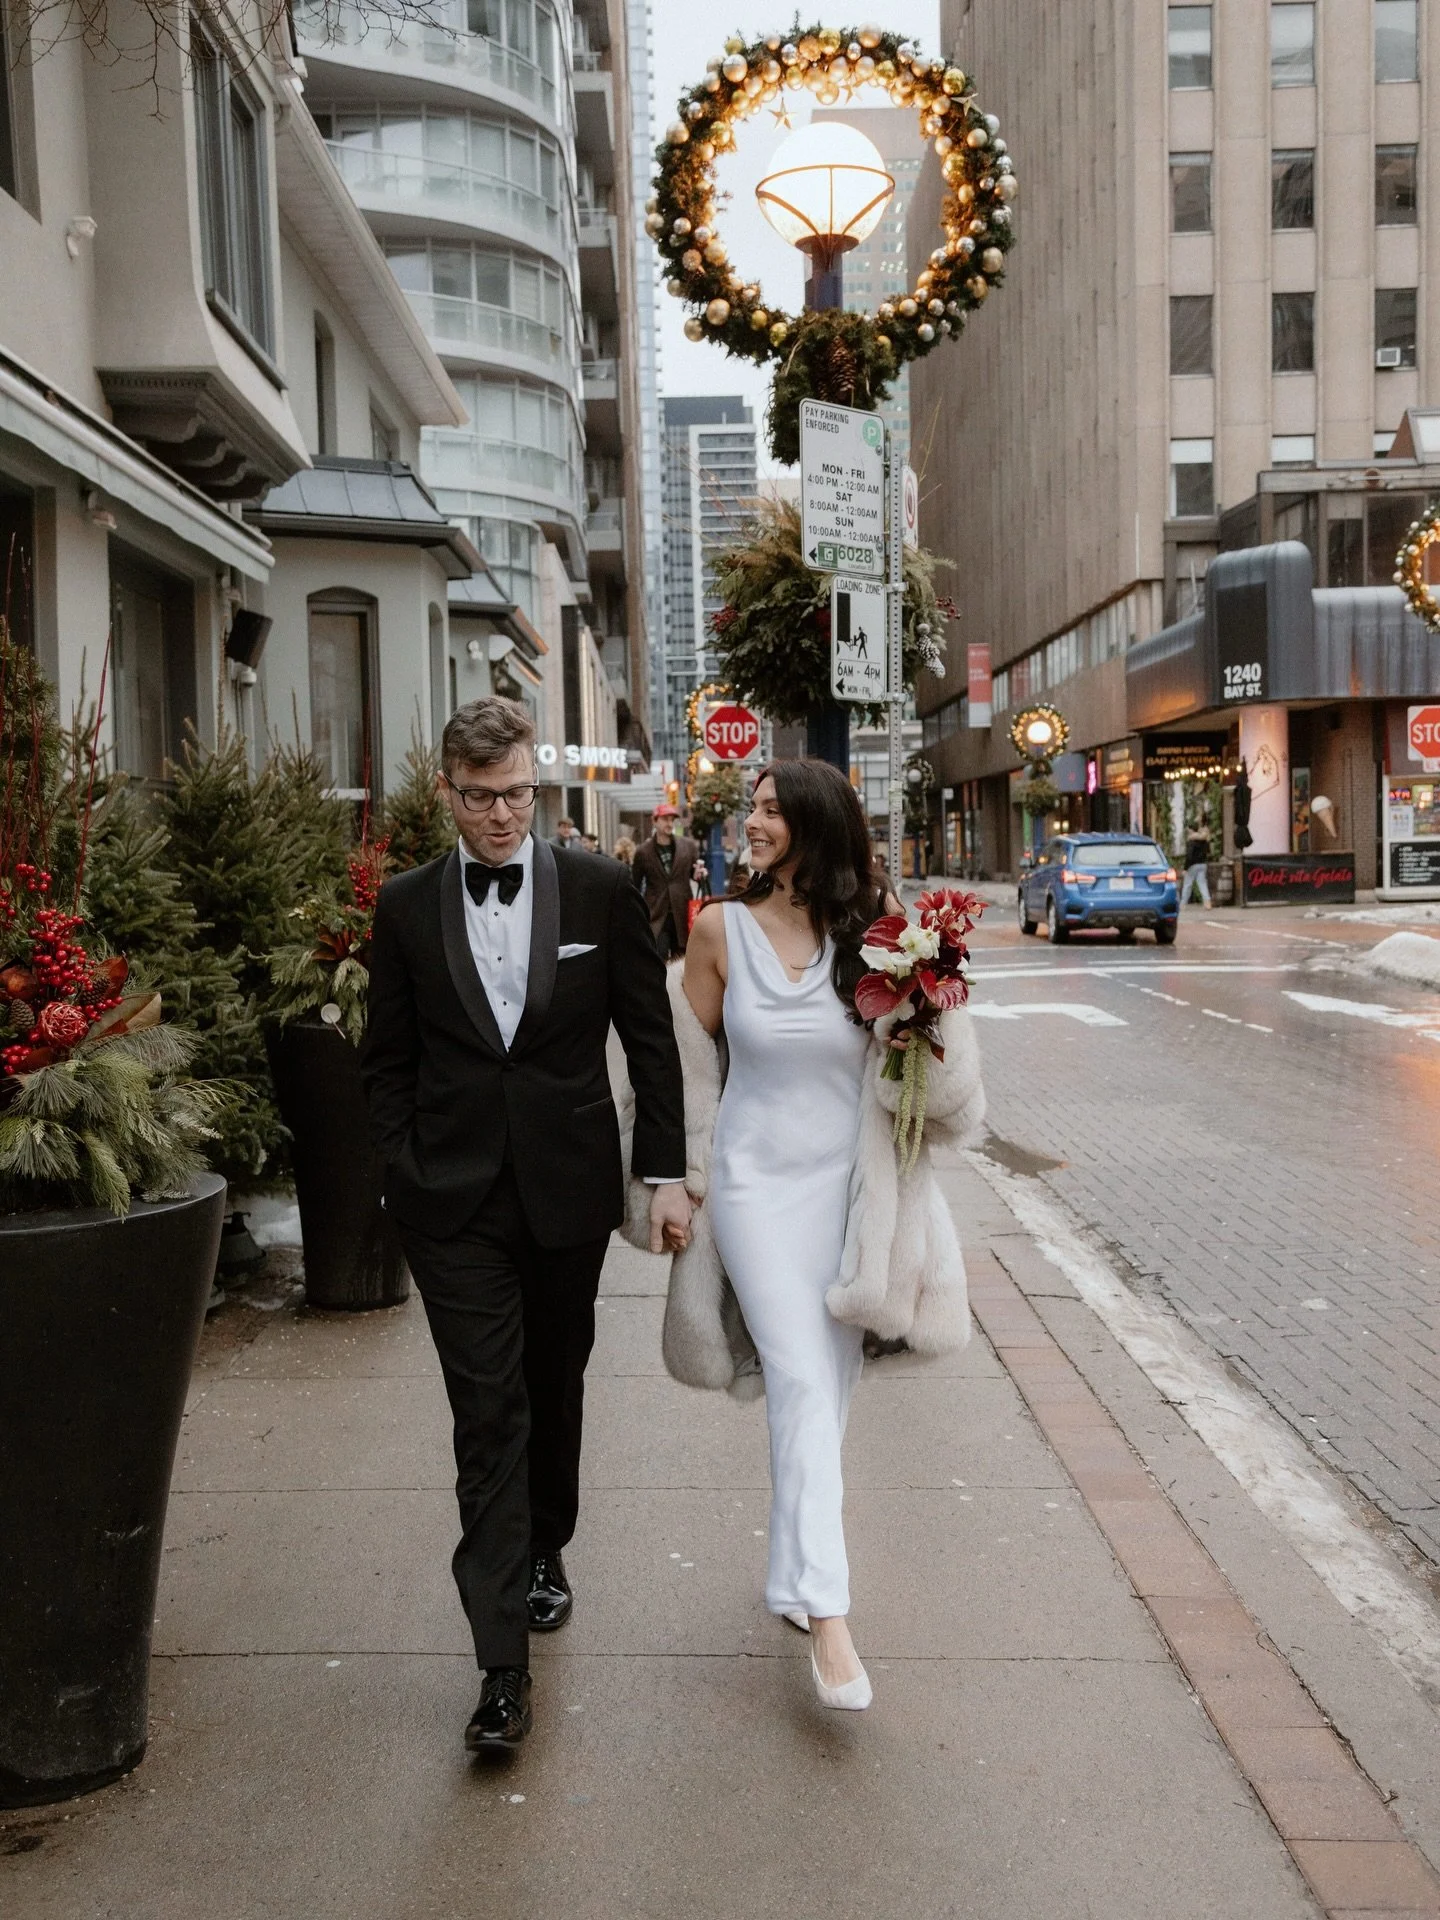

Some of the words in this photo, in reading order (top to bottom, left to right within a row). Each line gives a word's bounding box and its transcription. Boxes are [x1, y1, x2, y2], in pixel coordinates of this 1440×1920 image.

[806, 406, 819, 417] PAY
[820, 410, 850, 425] PARKING
[805, 418, 840, 434] ENFORCED
[822, 464, 843, 476] MON
[851, 469, 866, 480] FRI
[807, 474, 824, 486] 4:00
[826, 477, 839, 487] PM
[845, 481, 866, 493] 12:00
[867, 484, 880, 495] AM
[835, 491, 853, 503] SAT
[835, 516, 854, 528] SUN
[838, 546, 873, 564] 6028
[836, 579, 863, 593] LOADING
[865, 584, 881, 595] ZONE
[837, 662, 854, 677] 6AM
[864, 664, 881, 680] 4PM
[1223, 662, 1262, 685] 1240
[1223, 684, 1246, 699] BAY
[1245, 682, 1262, 697] ST.
[708, 721, 757, 745] STOP
[564, 744, 628, 769] SMOKE
[1389, 791, 1411, 800] ATM
